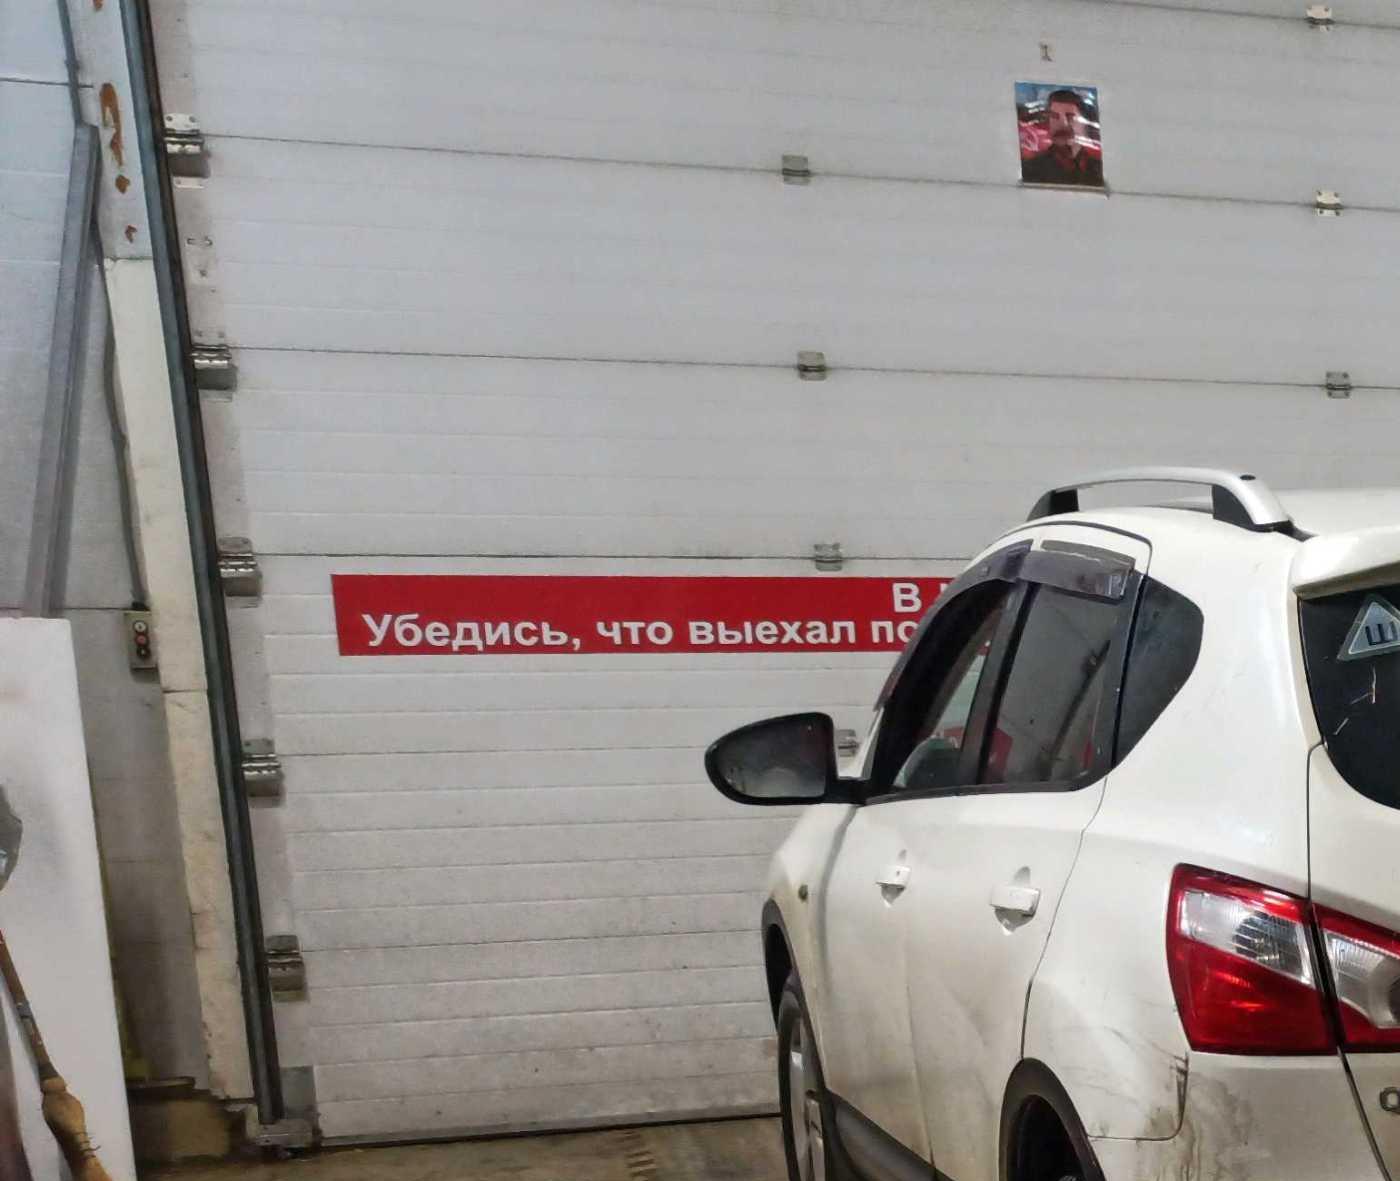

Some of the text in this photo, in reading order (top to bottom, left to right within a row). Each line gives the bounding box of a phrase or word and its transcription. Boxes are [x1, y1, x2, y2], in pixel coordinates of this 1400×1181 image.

[362, 613, 582, 651] Убедись,
[596, 622, 674, 645] что
[688, 620, 857, 645] выехал
